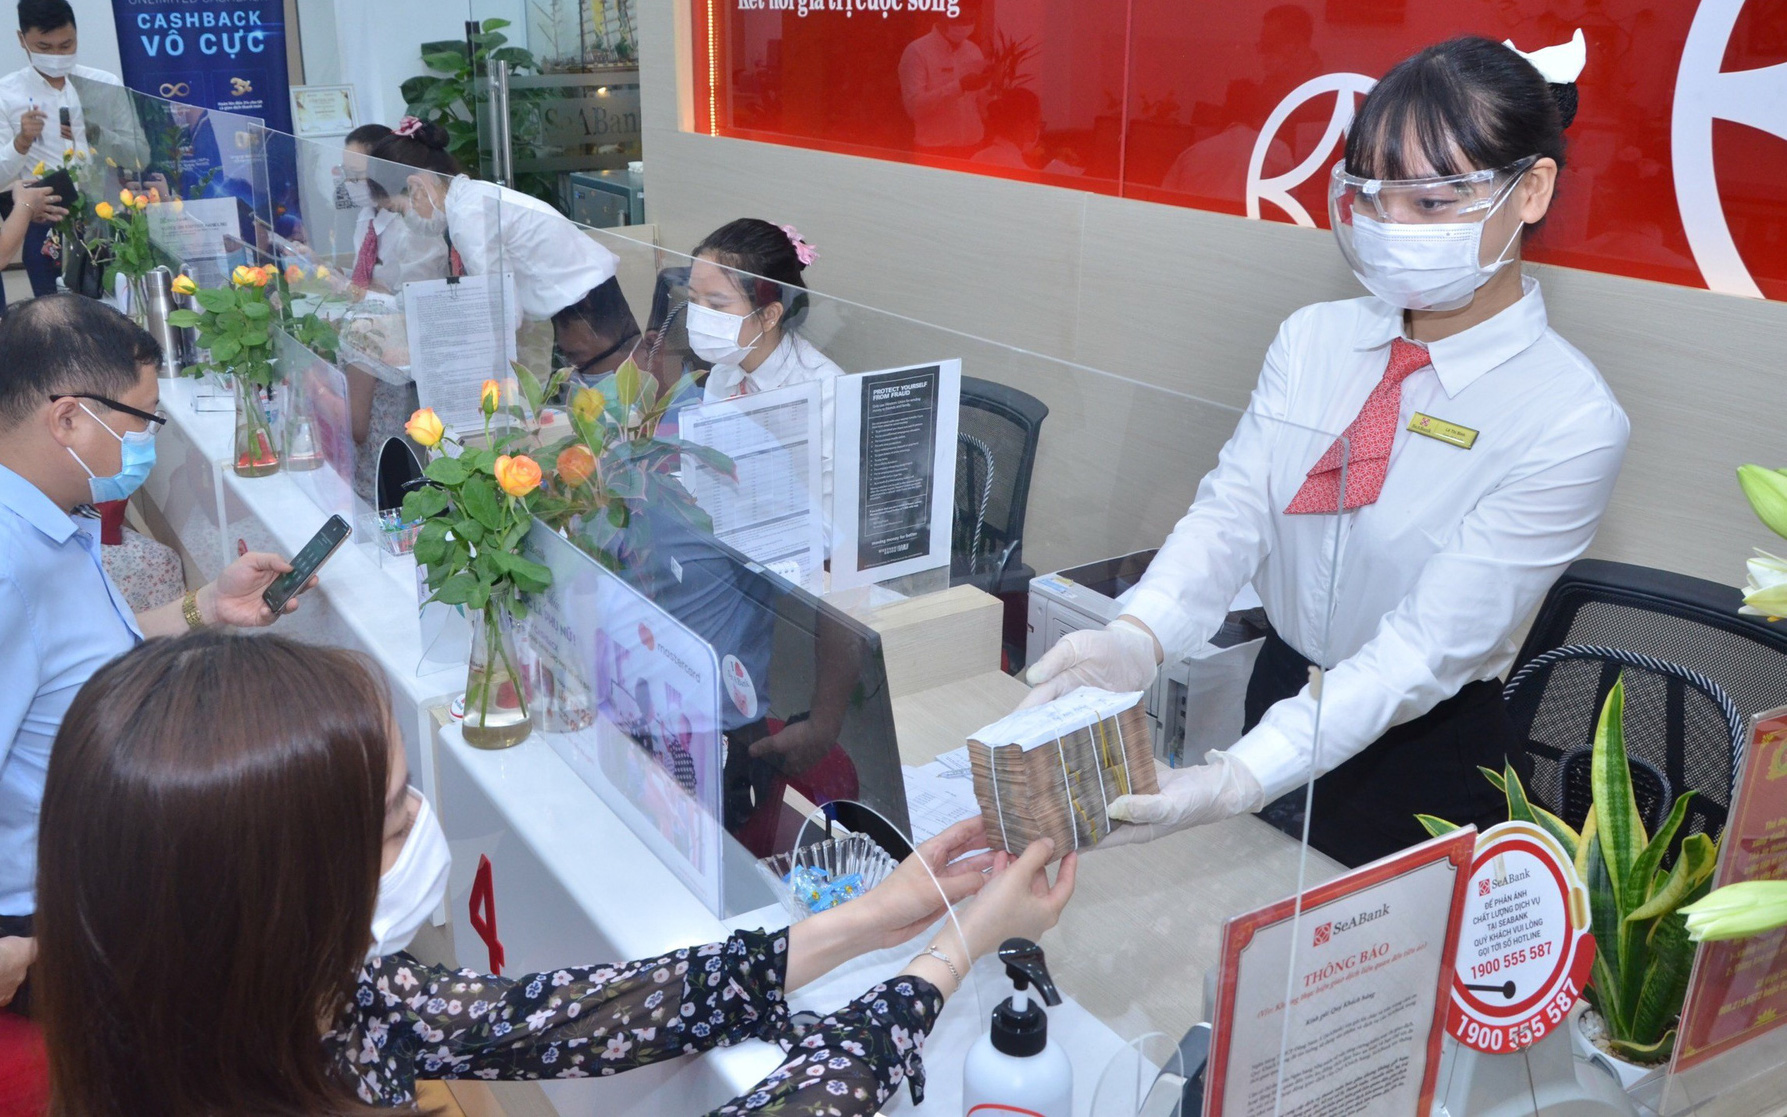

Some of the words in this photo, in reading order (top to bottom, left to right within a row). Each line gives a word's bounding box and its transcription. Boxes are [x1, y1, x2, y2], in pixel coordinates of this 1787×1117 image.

[137, 10, 262, 29] CASHBACK
[140, 29, 185, 57] VÔ
[200, 28, 265, 59] CỰC
[544, 106, 642, 136] SeABan
[872, 393, 890, 401] FROM
[890, 390, 910, 398] FRAUD
[873, 386, 900, 395] PROTECT
[900, 381, 928, 391] YOURSELF
[657, 643, 701, 684] mastercard
[1491, 868, 1531, 890] SeABank
[1473, 911, 1490, 925] CHẤT
[1491, 904, 1514, 919] LƯỢNG
[1515, 900, 1531, 913] DỊCH
[1531, 896, 1541, 907] VỤ
[1484, 896, 1493, 910] ĐỂ
[1494, 892, 1512, 906] PHẢN
[1513, 889, 1527, 901] ÁNH
[1333, 903, 1390, 935] SeABank
[1474, 935, 1488, 948] QUÝ
[1489, 927, 1512, 942] KHÁCH
[1513, 925, 1525, 935] VUI
[1525, 917, 1543, 930] LÒNG
[1487, 922, 1498, 932] TẠI
[1498, 912, 1528, 928] SEABANK
[1478, 946, 1490, 957] GỌI
[1491, 941, 1502, 952] TỚI
[1503, 937, 1512, 949] SỐ
[1513, 930, 1541, 945] HOTLINE
[1303, 955, 1356, 988] THÔNG
[1360, 942, 1390, 964] BÁO
[1470, 958, 1500, 980] 1900
[1503, 949, 1526, 968] 555
[1530, 941, 1552, 960] 587
[1275, 997, 1299, 1011] Khng
[1456, 1014, 1502, 1050] 1900
[1508, 1015, 1545, 1048] 555
[1545, 977, 1578, 1024] 587
